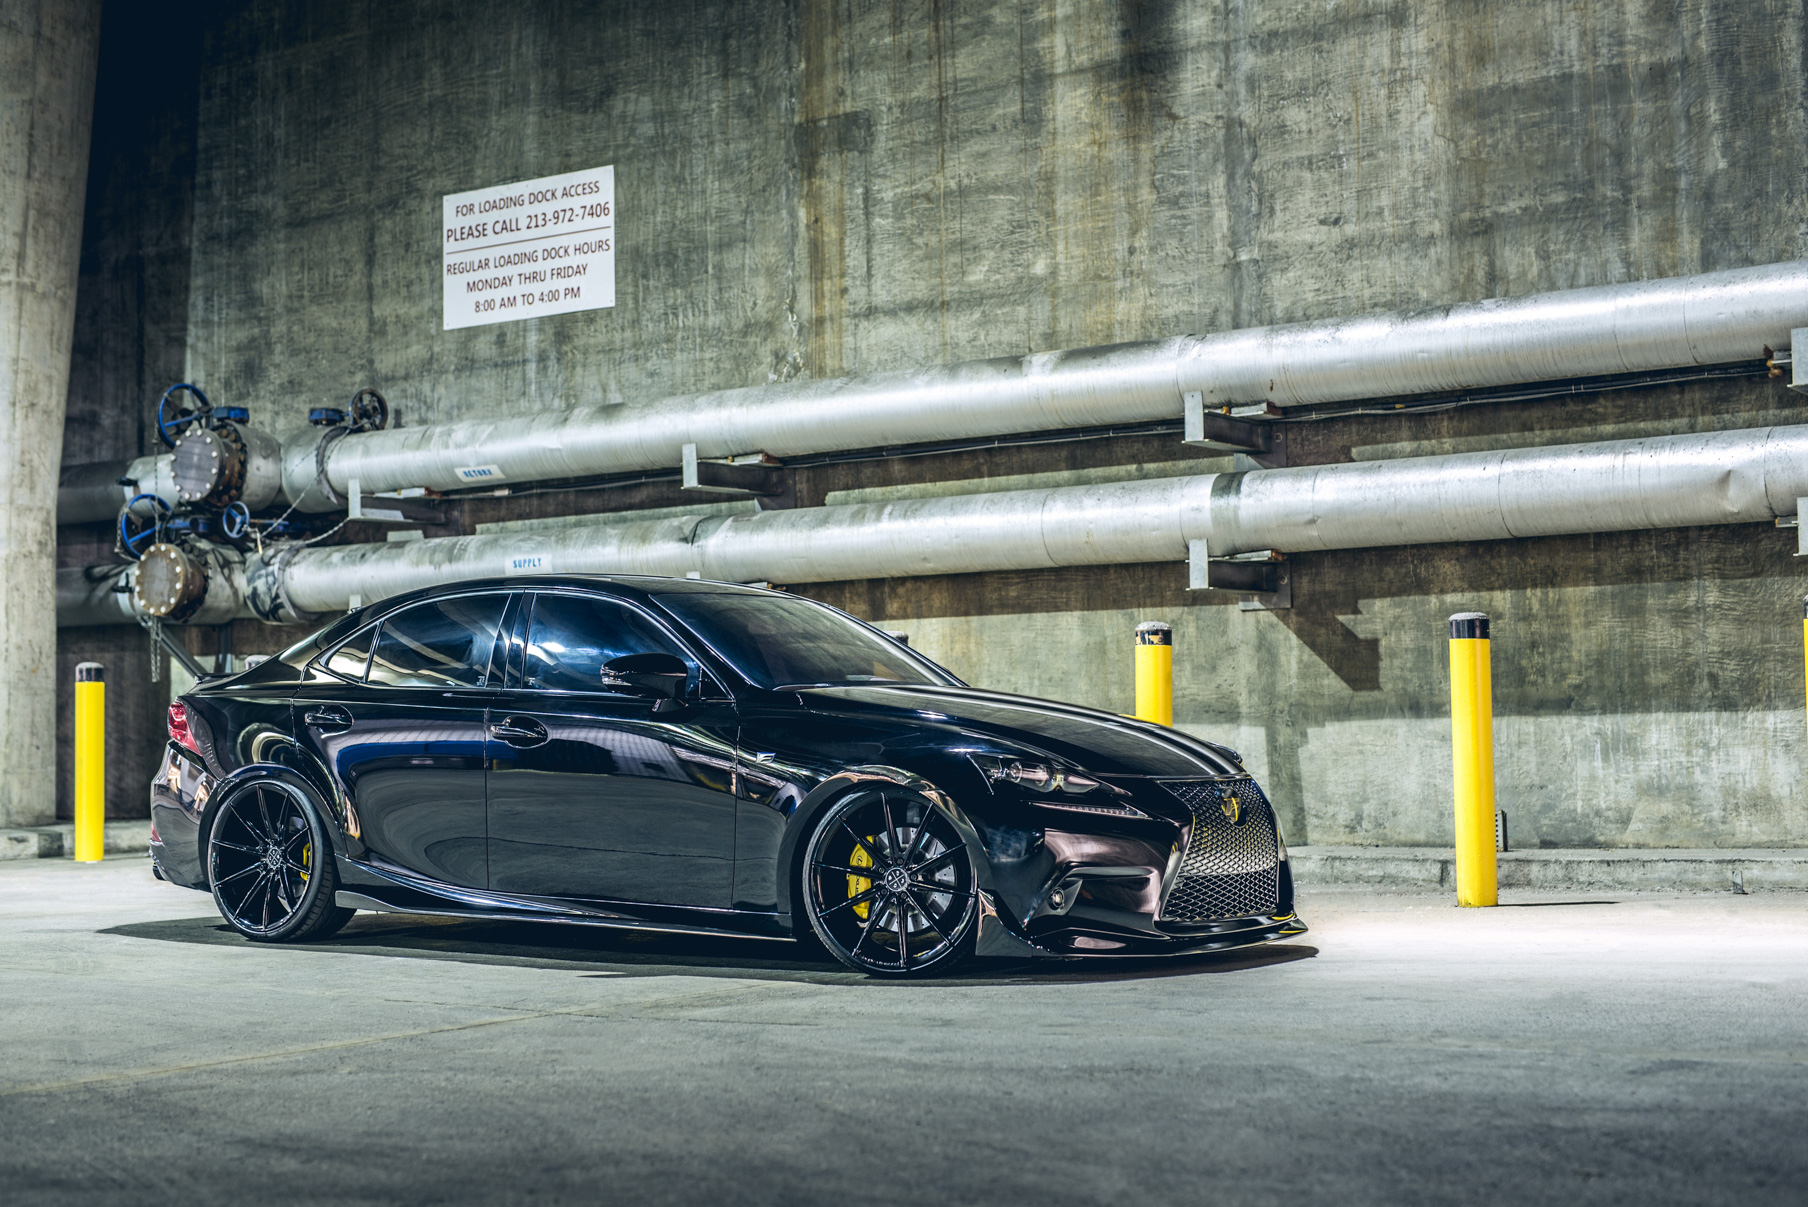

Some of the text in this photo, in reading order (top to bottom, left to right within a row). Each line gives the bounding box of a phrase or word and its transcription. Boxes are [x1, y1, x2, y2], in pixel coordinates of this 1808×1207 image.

[455, 180, 600, 218] FOR LOADING DOCK ACCESS
[446, 201, 610, 243] PLEASE CALL 213-972-7406
[446, 238, 611, 276] REGULAR LOADING DOCK HOURS
[466, 263, 588, 293] MONDAY THRU FRIDAY
[474, 286, 581, 313] 8:00 AM TO 4:00 PM
[513, 557, 542, 569] SUPPLY
